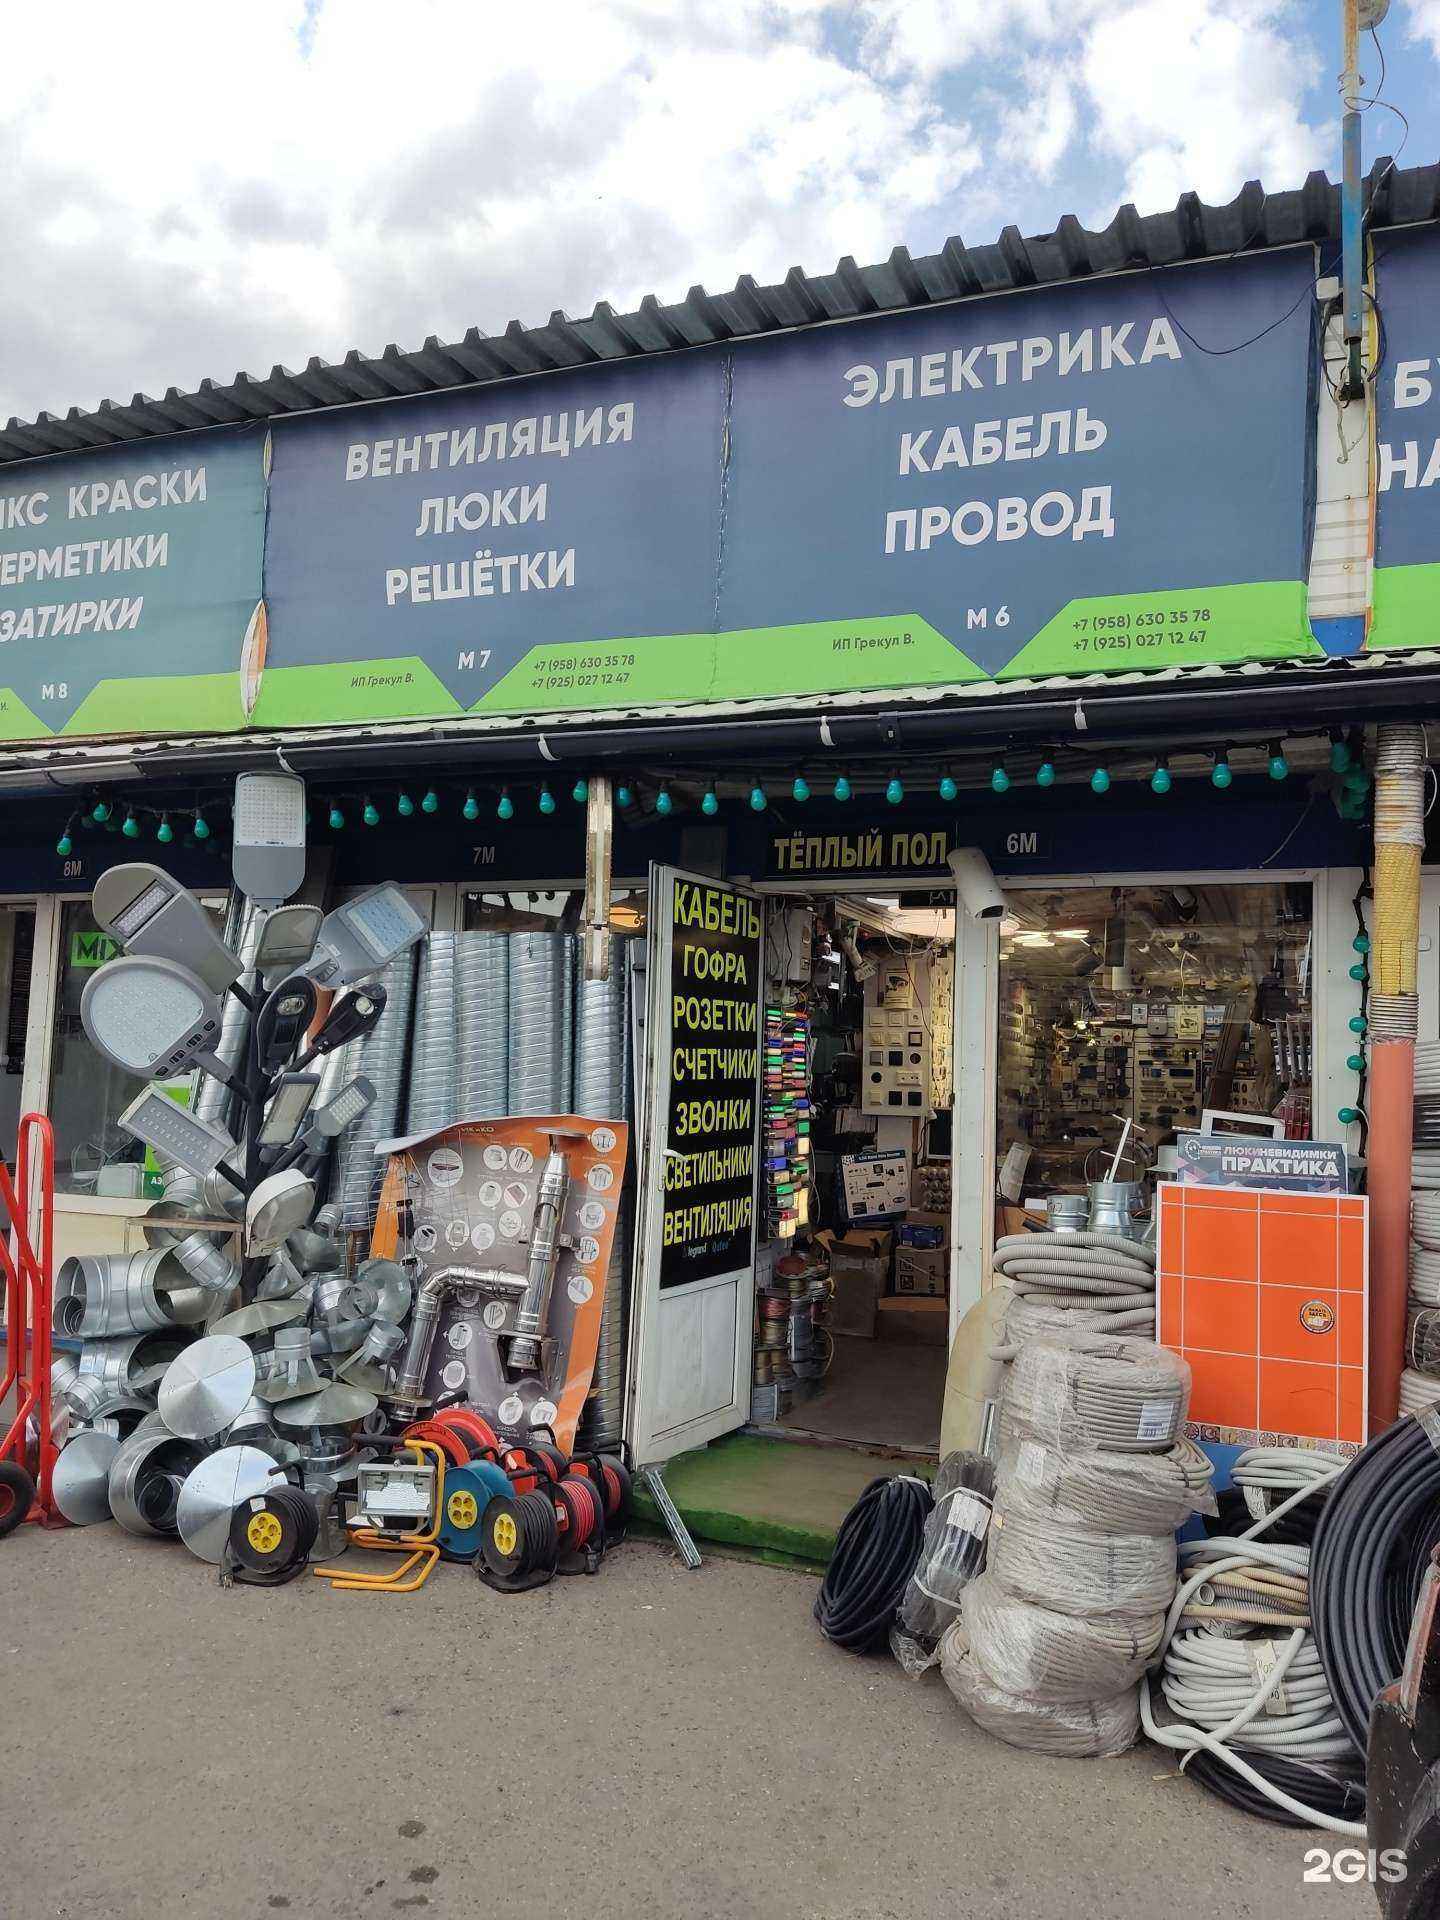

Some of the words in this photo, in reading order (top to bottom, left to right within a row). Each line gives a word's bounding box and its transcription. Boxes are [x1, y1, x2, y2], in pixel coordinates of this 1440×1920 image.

[842, 317, 1182, 408] ЭЛЕКТРИКА
[1394, 356, 1440, 409] Б
[345, 402, 636, 481] ВЕНТИЛЯЦИЯ
[899, 408, 1109, 475] КАБЕЛЬ
[0, 492, 49, 530] КС
[68, 467, 207, 520] КРАСКИ
[415, 483, 547, 537] ЛЮКИ
[884, 485, 1116, 554] ПРОВОД
[0, 532, 169, 587] ЕРМЕТИКИ
[385, 549, 576, 606] РЕШЁТКИ
[0, 597, 144, 643] ЗАТИРКИ
[996, 606, 1010, 627] 6
[1072, 619, 1088, 631] +7
[1092, 615, 1132, 631] (958)
[1136, 611, 1164, 627] 630
[1170, 610, 1189, 625] 35
[1192, 609, 1211, 623] 78
[480, 650, 491, 668] 7
[832, 638, 851, 650] ИП
[854, 636, 901, 652] Грекул
[1073, 639, 1089, 652] +7
[1094, 635, 1132, 652] (925)
[1136, 633, 1163, 647] 027
[1169, 632, 1184, 645] 12
[1188, 630, 1207, 644] 47
[351, 677, 366, 688] ИП
[367, 675, 402, 688] Грекул
[531, 678, 545, 689] +7
[546, 674, 575, 689] (925)
[577, 673, 598, 687] 027
[600, 673, 613, 685] 12
[616, 672, 630, 684] 47
[533, 660, 545, 671] +7
[548, 657, 577, 671] (958)
[580, 657, 601, 669] 630
[604, 656, 618, 668] 35
[620, 655, 635, 667] 78
[774, 827, 882, 869] ТЁПЛЫЙ
[892, 832, 947, 866] ПОЛ
[1007, 832, 1037, 854] 6М
[674, 880, 760, 939] КАБЕЛЬ
[683, 944, 748, 984] ГОФРА
[673, 995, 757, 1032] РОЗЕТКИ
[672, 1047, 757, 1081] СЧЕТЧИКИ
[676, 1098, 750, 1136] ЗВОНКИ
[664, 1145, 752, 1191] СВЕТИЛЬНИКИ
[1222, 1156, 1339, 1176] ПРАКТИКА
[664, 1196, 752, 1247] ВЕНТИЛЯЦИЯ
